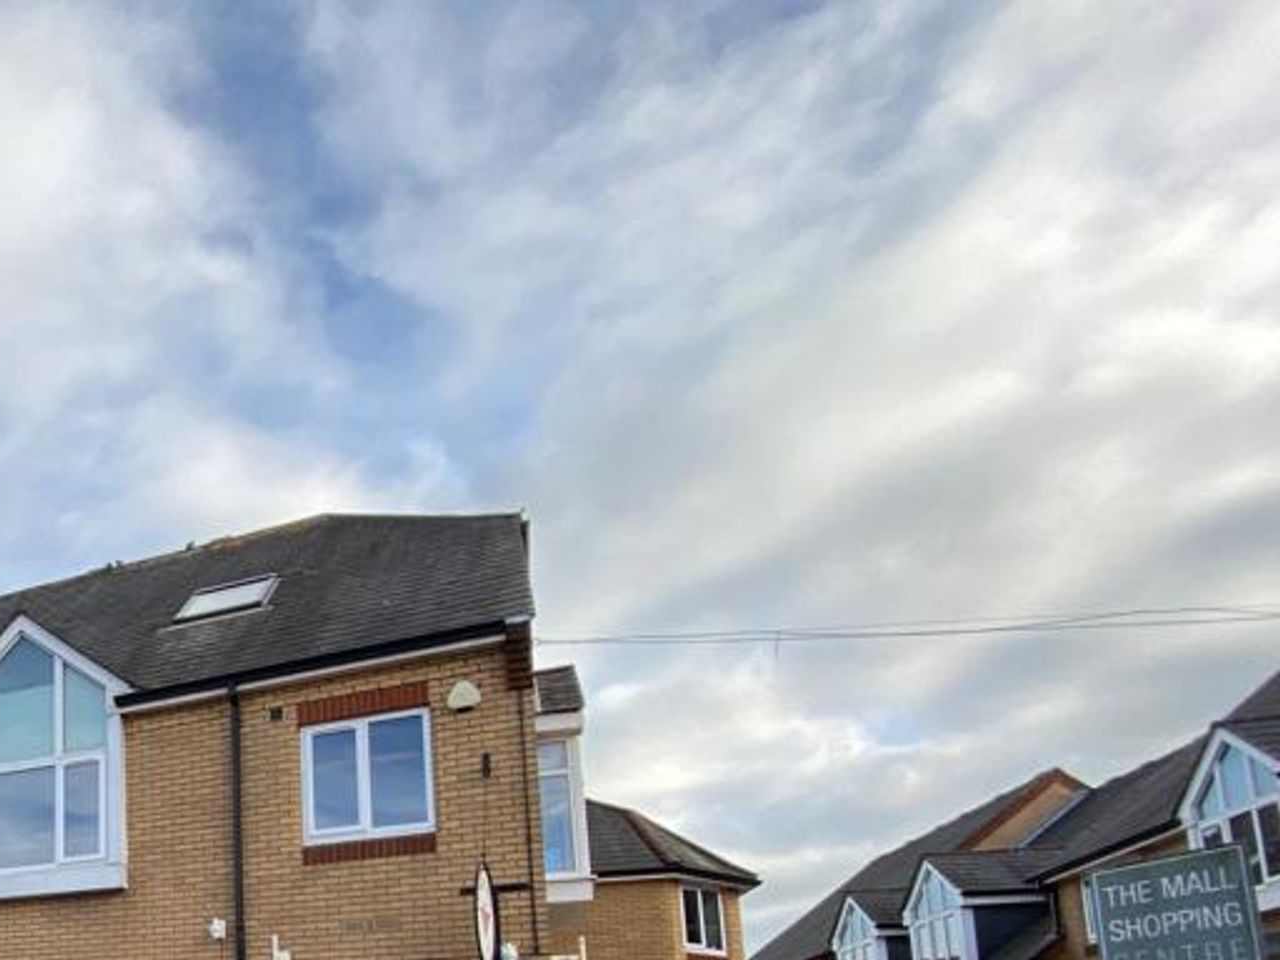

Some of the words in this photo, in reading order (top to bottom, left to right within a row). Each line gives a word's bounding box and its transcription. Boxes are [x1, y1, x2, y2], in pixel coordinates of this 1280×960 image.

[1101, 879, 1154, 908] THE
[1160, 866, 1236, 899] MALL
[1109, 902, 1243, 942] SHOPPING
